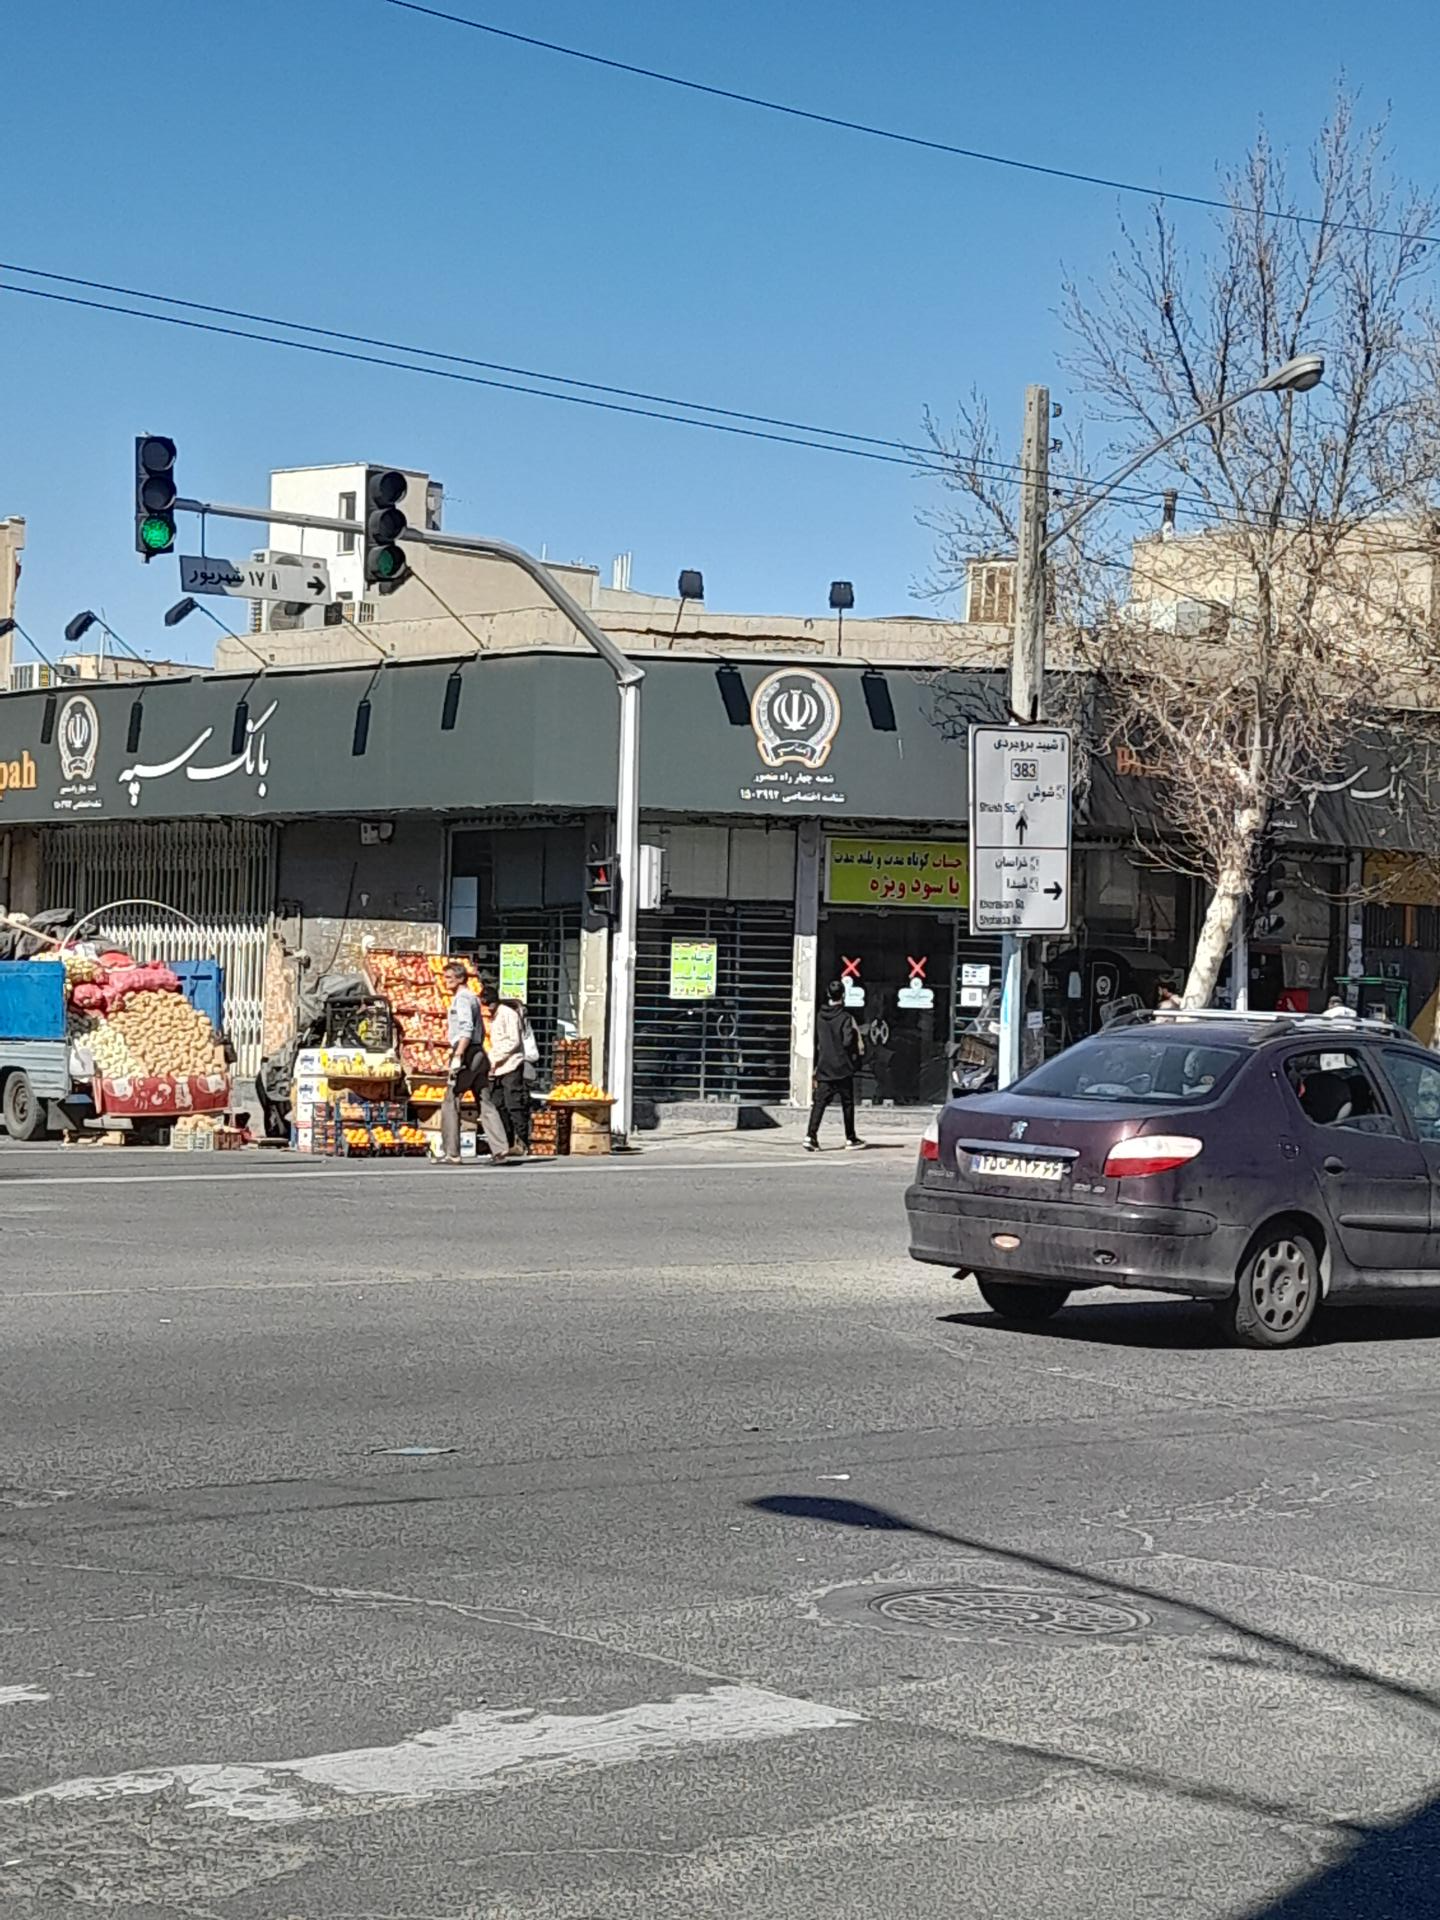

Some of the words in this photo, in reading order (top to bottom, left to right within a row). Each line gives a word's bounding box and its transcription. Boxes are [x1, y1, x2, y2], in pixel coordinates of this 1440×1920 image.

[189, 567, 245, 586] شهریور
[249, 571, 265, 587] ۱۷
[186, 699, 279, 798] بانک
[1035, 738, 1059, 752] شهید
[118, 726, 214, 807] سپه
[1013, 762, 1037, 778] 383
[1027, 784, 1055, 803] شوش
[994, 855, 1029, 872] خراسان
[869, 875, 906, 899] ویژه
[910, 877, 944, 900] سود
[948, 876, 960, 900] با
